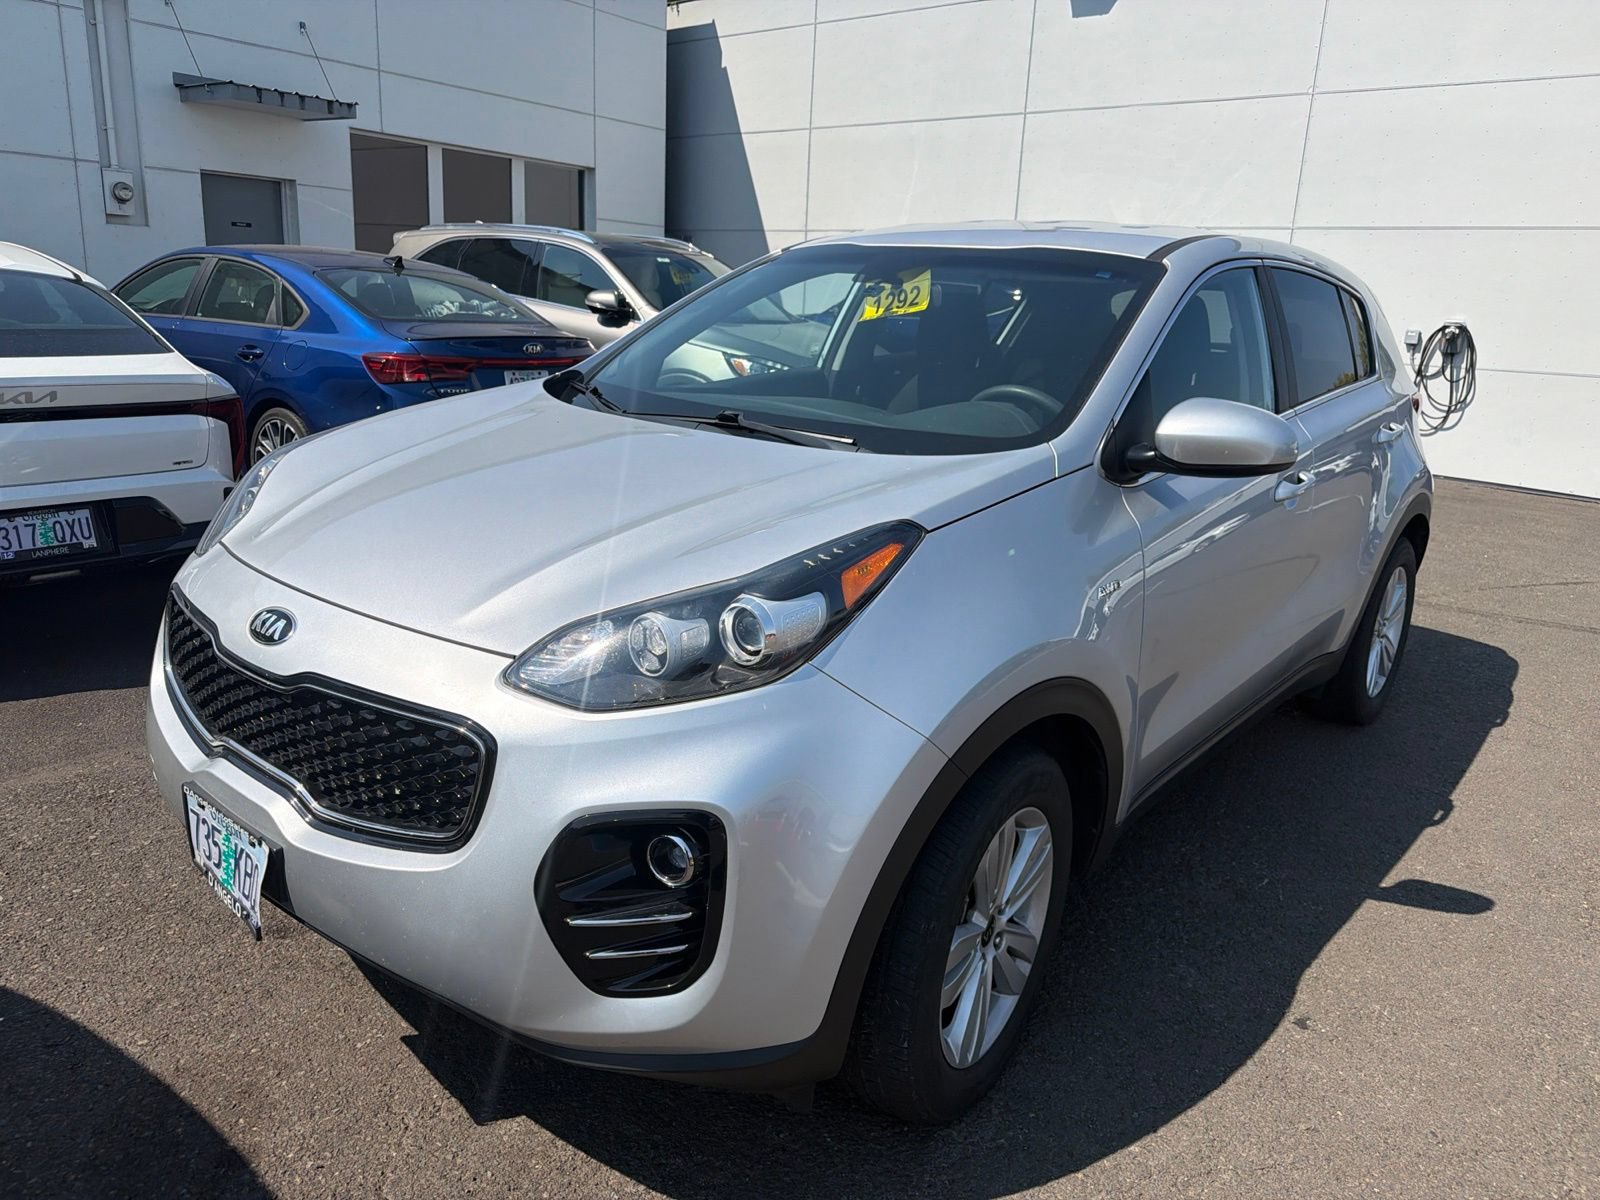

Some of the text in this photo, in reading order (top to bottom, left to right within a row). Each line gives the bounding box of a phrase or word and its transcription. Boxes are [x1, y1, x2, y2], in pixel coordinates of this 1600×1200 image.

[873, 285, 921, 315] 1292
[0, 516, 92, 551] 317 QXU
[31, 546, 70, 558] LANPHERE
[251, 611, 287, 640] KIA
[190, 808, 222, 870] 735
